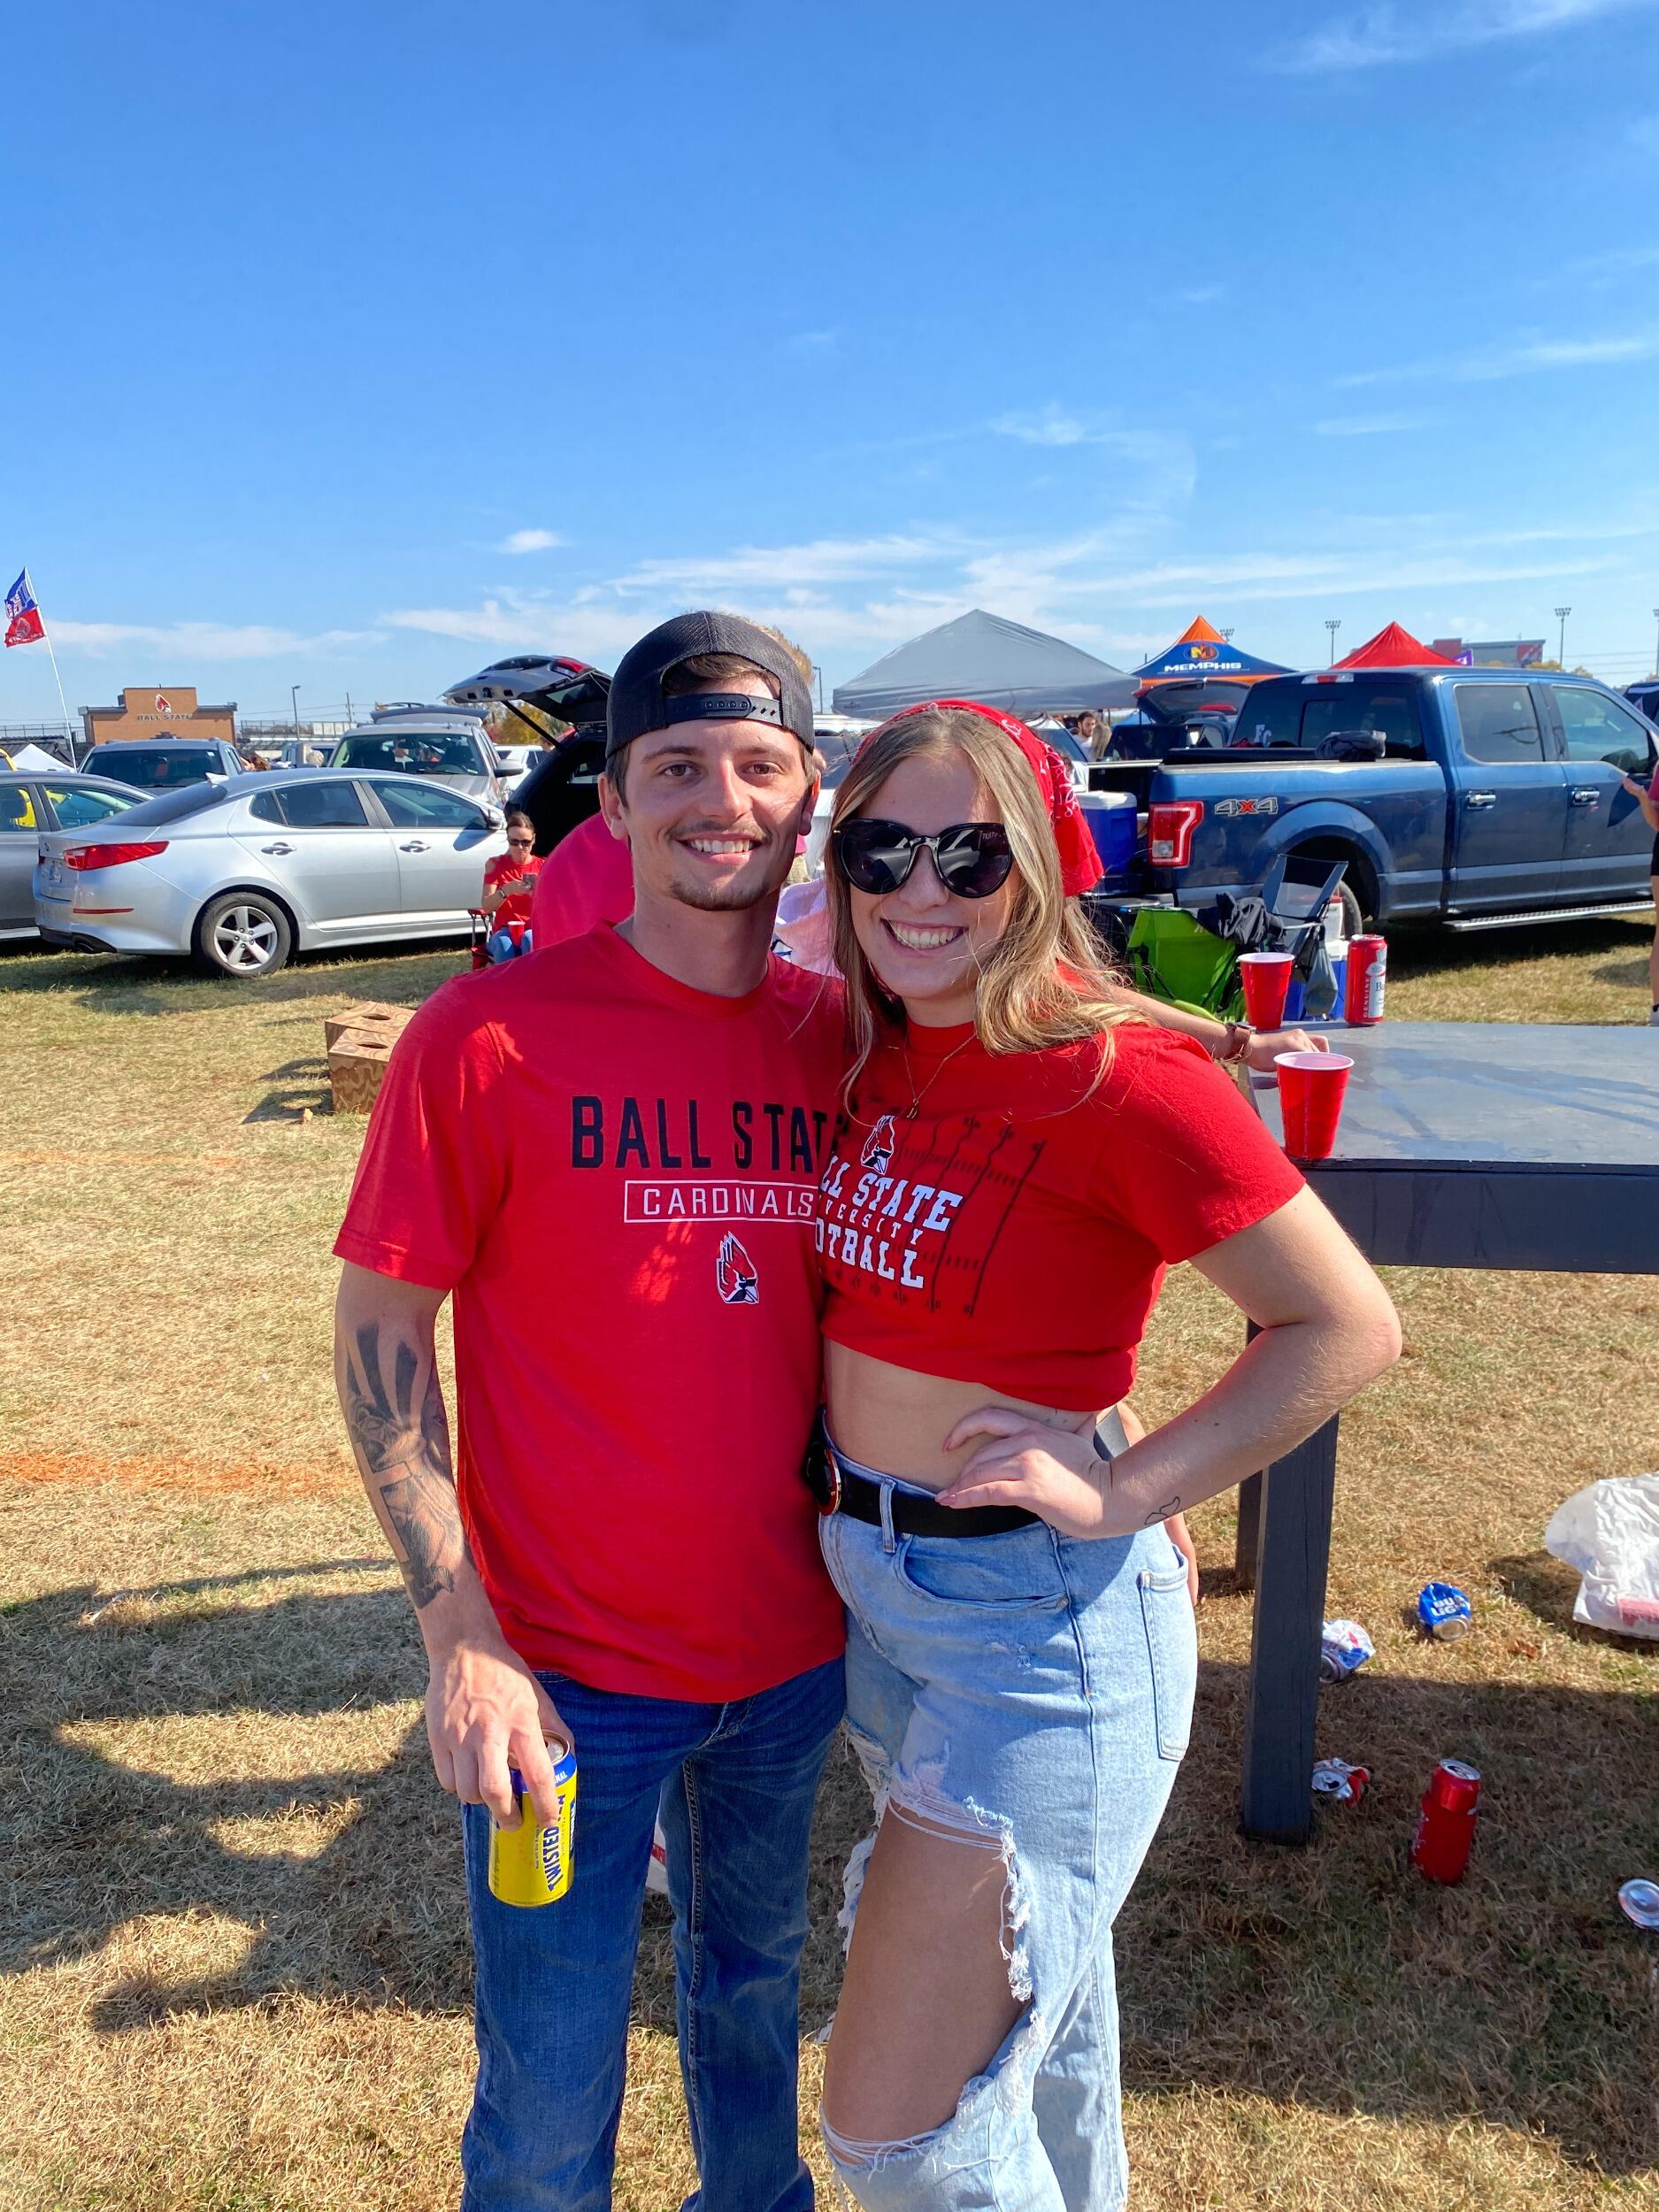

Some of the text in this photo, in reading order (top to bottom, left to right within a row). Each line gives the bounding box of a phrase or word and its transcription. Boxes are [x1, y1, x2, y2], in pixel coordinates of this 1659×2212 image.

[1164, 662, 1241, 672] MEMPHIS
[572, 1095, 712, 1169] BALL
[643, 1187, 814, 1217] CARDINALS
[819, 1154, 964, 1232] LL STATE
[824, 1198, 924, 1246] VERSITY
[815, 1217, 925, 1289] OTBALL
[1430, 1606, 1458, 1617] LIG
[1433, 1597, 1456, 1608] BU
[541, 1825, 564, 1893] TWISTED
